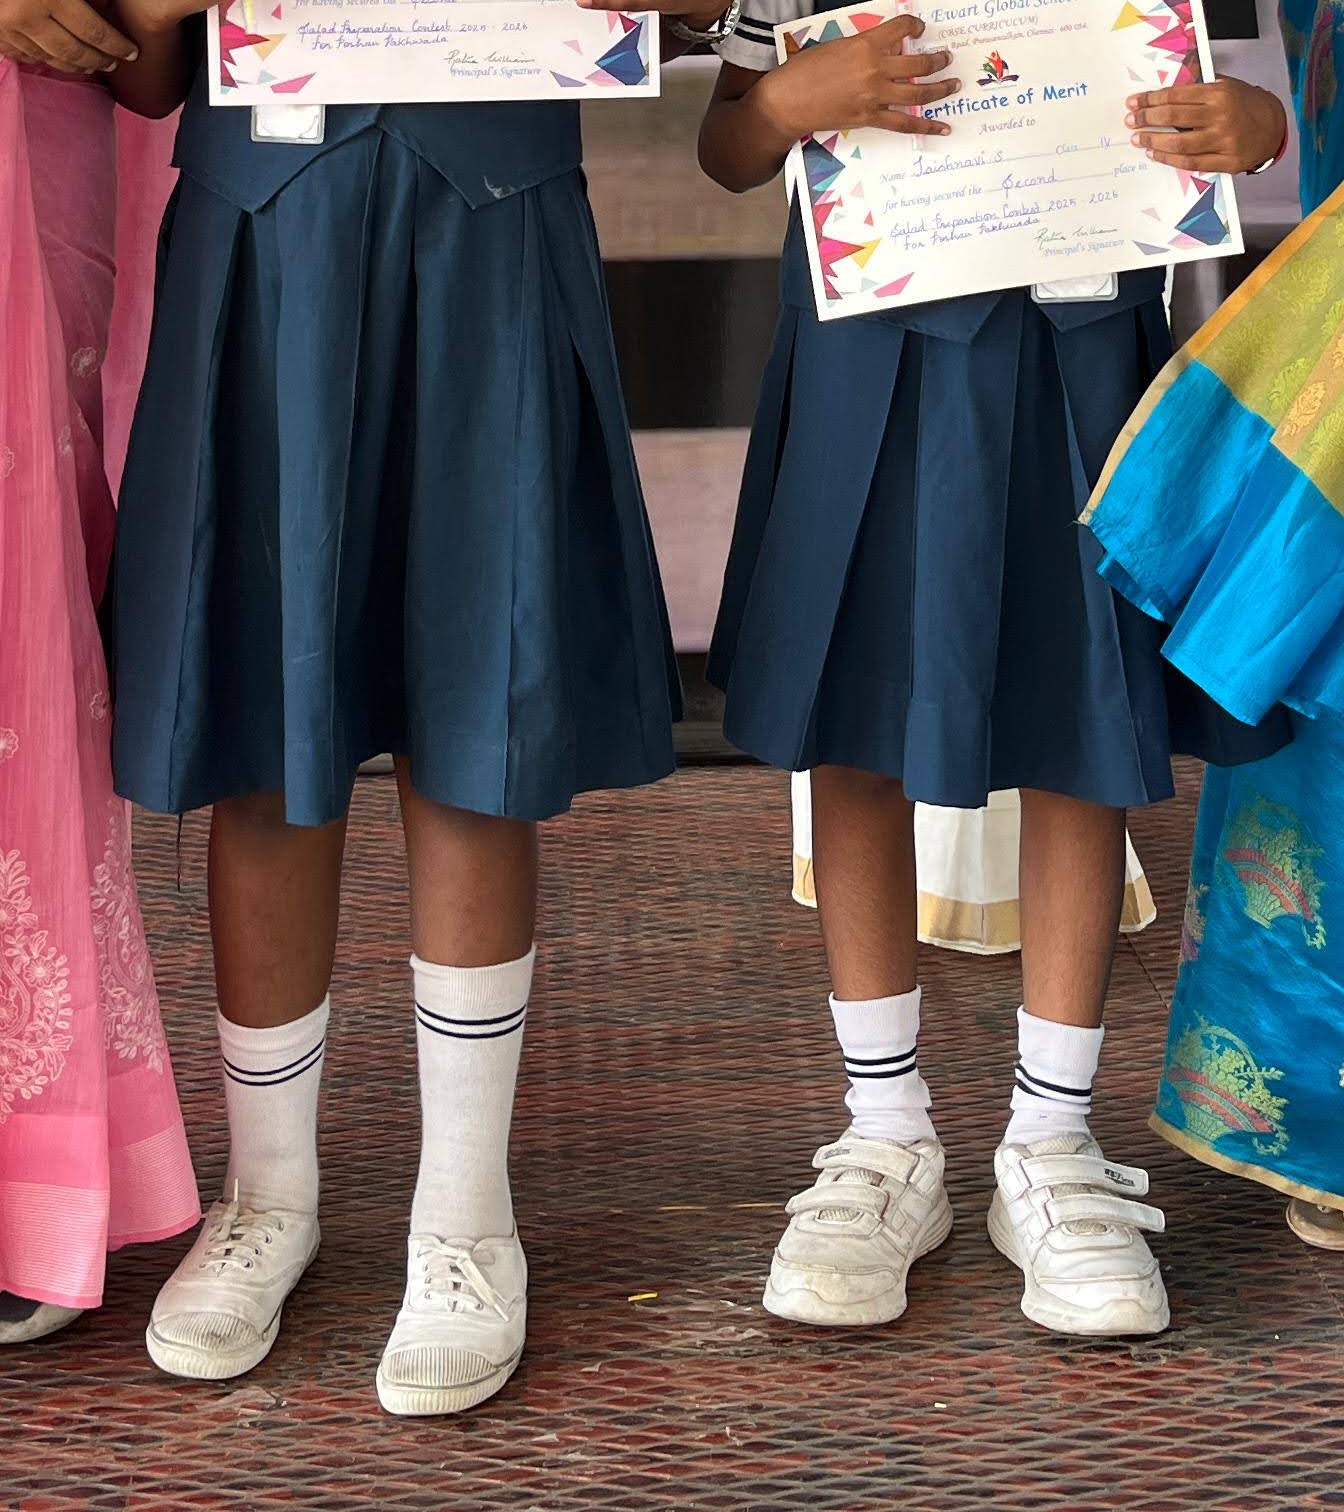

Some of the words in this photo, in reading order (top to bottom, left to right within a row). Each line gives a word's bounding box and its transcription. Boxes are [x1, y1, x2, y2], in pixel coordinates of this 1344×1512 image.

[932, 3, 980, 23] Ewart
[922, 94, 1010, 120] ertificate
[1017, 87, 1034, 105] of
[1043, 81, 1089, 102] Merit
[979, 119, 1023, 136] Awarded
[1025, 118, 1037, 128] to
